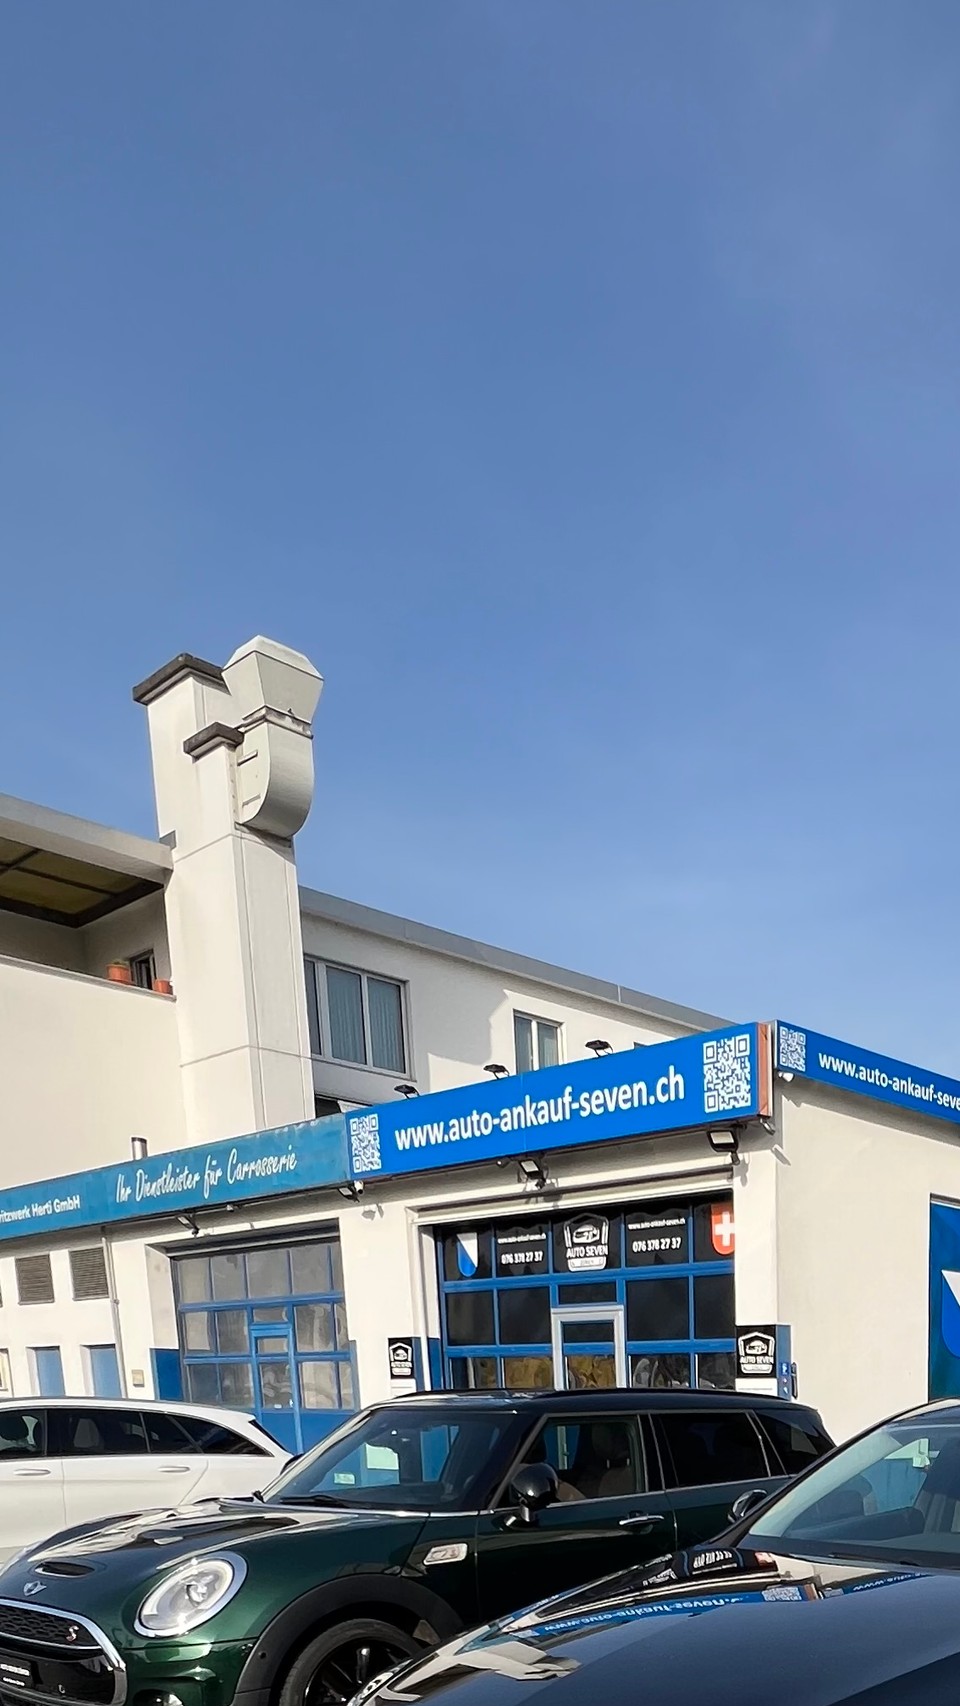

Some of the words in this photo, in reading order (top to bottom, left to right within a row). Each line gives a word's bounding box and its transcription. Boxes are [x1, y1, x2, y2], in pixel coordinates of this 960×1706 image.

[395, 1065, 685, 1151] www.auto-ankauf-seven.ch
[116, 1173, 132, 1204] Ihr
[135, 1162, 201, 1202] Dienstleister
[203, 1154, 223, 1199] für
[227, 1144, 298, 1185] Carrosserie
[53, 1194, 81, 1213] GmbH
[566, 1247, 585, 1258] AUTO
[585, 1244, 608, 1257] SEVEN
[632, 1240, 647, 1252] 076
[660, 1237, 671, 1250] 27
[671, 1236, 682, 1249] 37
[525, 1251, 534, 1262] 27
